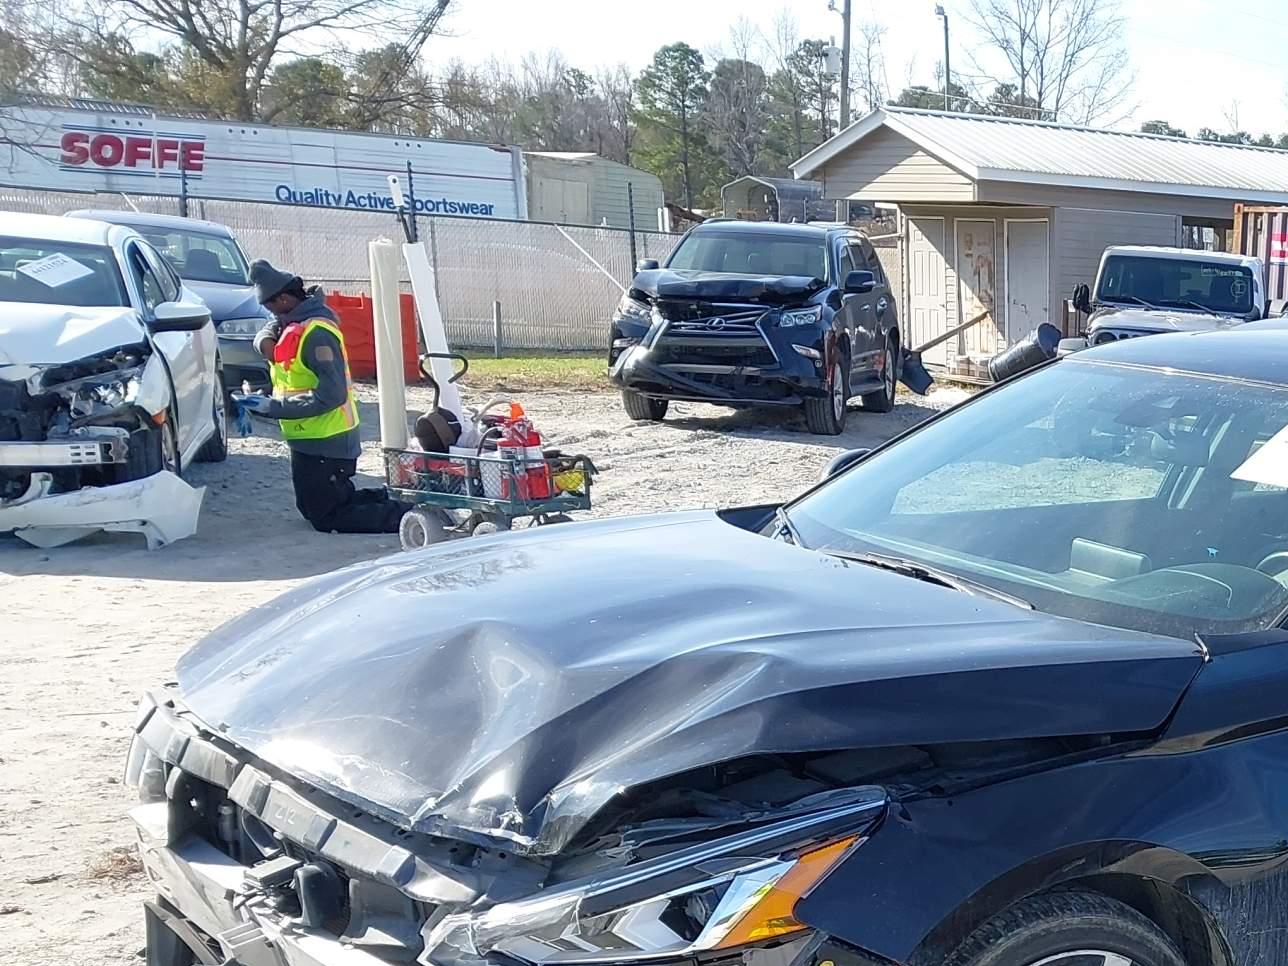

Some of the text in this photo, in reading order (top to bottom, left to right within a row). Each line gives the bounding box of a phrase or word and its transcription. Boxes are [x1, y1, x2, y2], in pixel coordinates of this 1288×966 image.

[61, 131, 205, 171] SOFFE
[275, 185, 341, 206] Quality
[345, 190, 396, 209] Active
